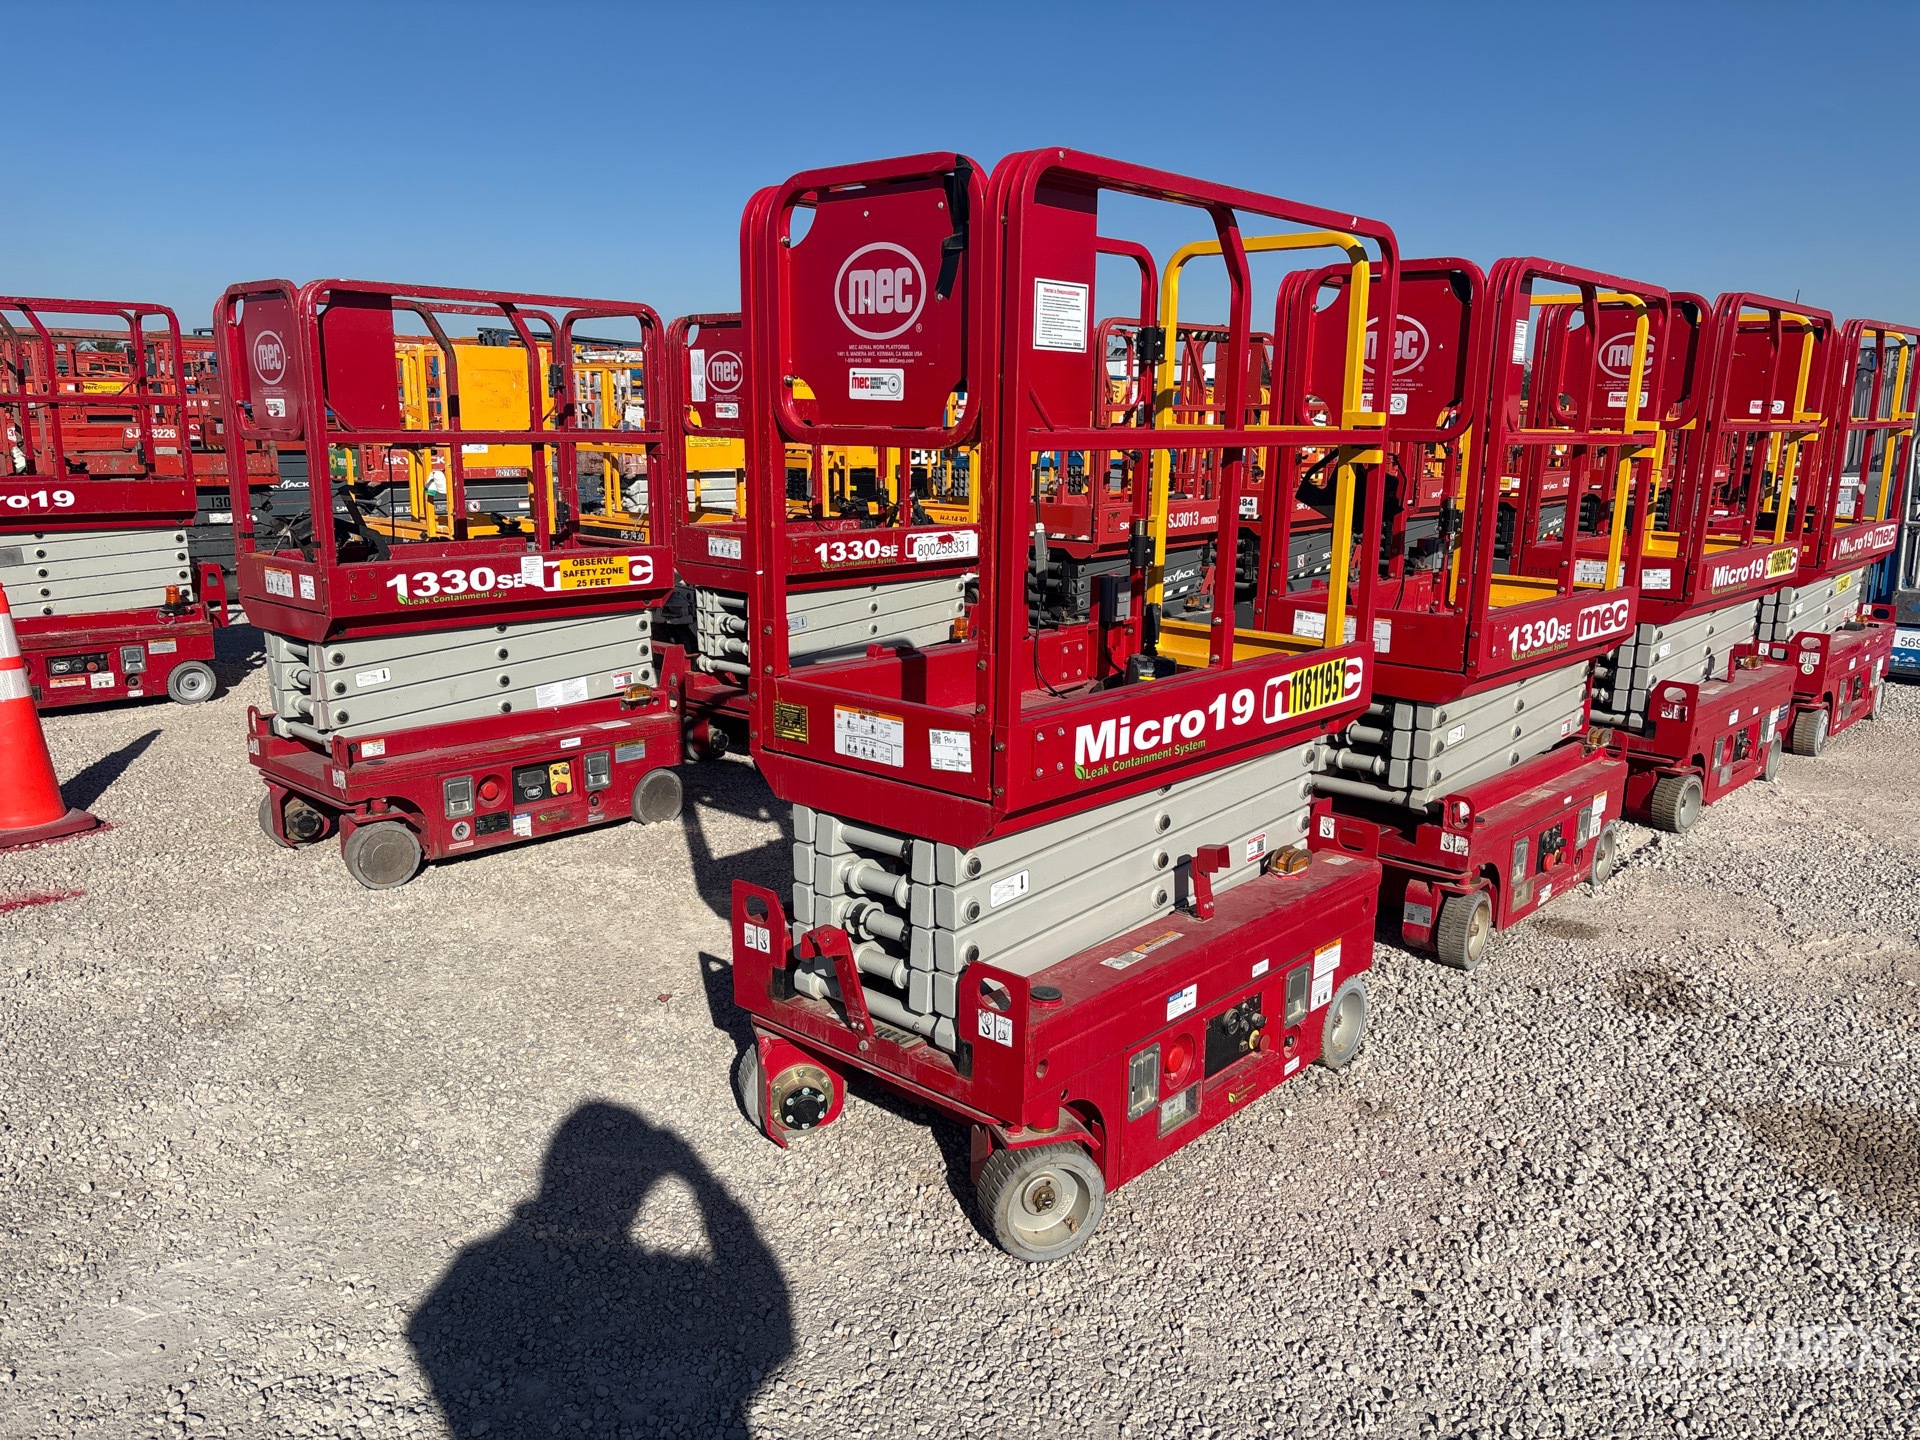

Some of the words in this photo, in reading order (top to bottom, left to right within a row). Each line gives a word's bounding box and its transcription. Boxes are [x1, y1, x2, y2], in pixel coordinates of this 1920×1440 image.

[848, 267, 912, 314] mec
[152, 429, 176, 438] 3226
[1168, 511, 1199, 528] SJ3013
[572, 557, 614, 567] OBSERVE
[562, 568, 598, 578] SAFETY
[600, 567, 625, 576] ZONE
[1163, 569, 1195, 584] SKYJACK
[1712, 558, 1764, 588] Micro19
[576, 579, 587, 588] 25
[589, 577, 611, 587] FEET
[408, 597, 430, 606] Leak
[433, 590, 490, 603] Containment
[1578, 603, 1628, 637] mec
[1292, 659, 1347, 713] 11811951
[1074, 688, 1255, 766] Micro19
[1085, 763, 1109, 780] Leak
[1112, 747, 1172, 772] Containment
[1174, 739, 1206, 756] System
